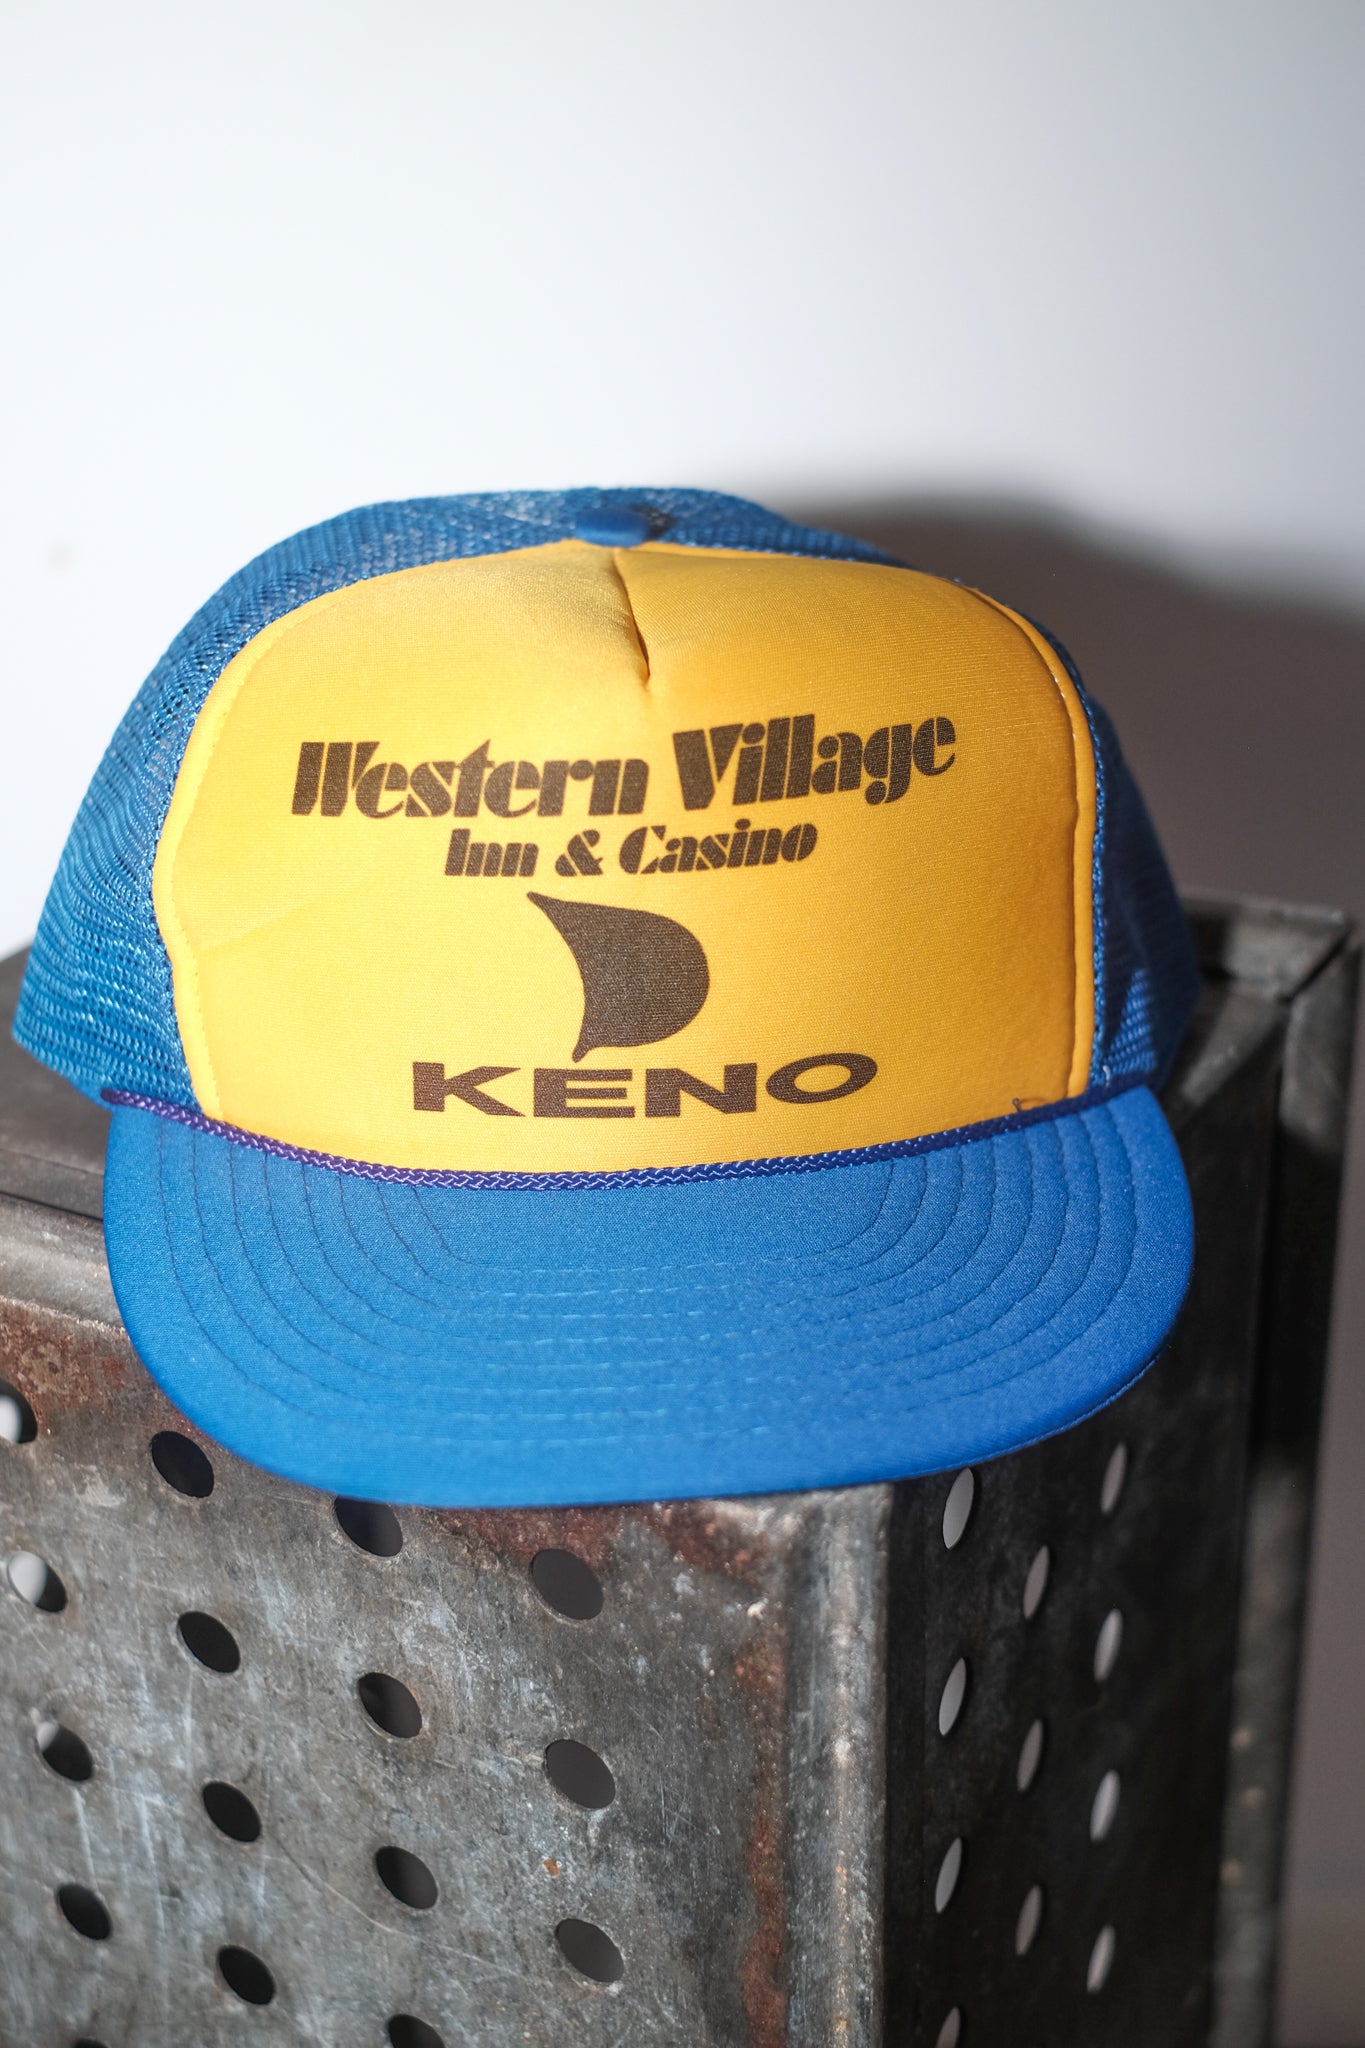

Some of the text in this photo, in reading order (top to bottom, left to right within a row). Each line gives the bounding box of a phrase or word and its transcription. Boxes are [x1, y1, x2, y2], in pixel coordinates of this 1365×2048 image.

[291, 713, 957, 819] Western Village
[443, 818, 818, 877] Inn & Casino
[412, 1053, 878, 1118] KENO
